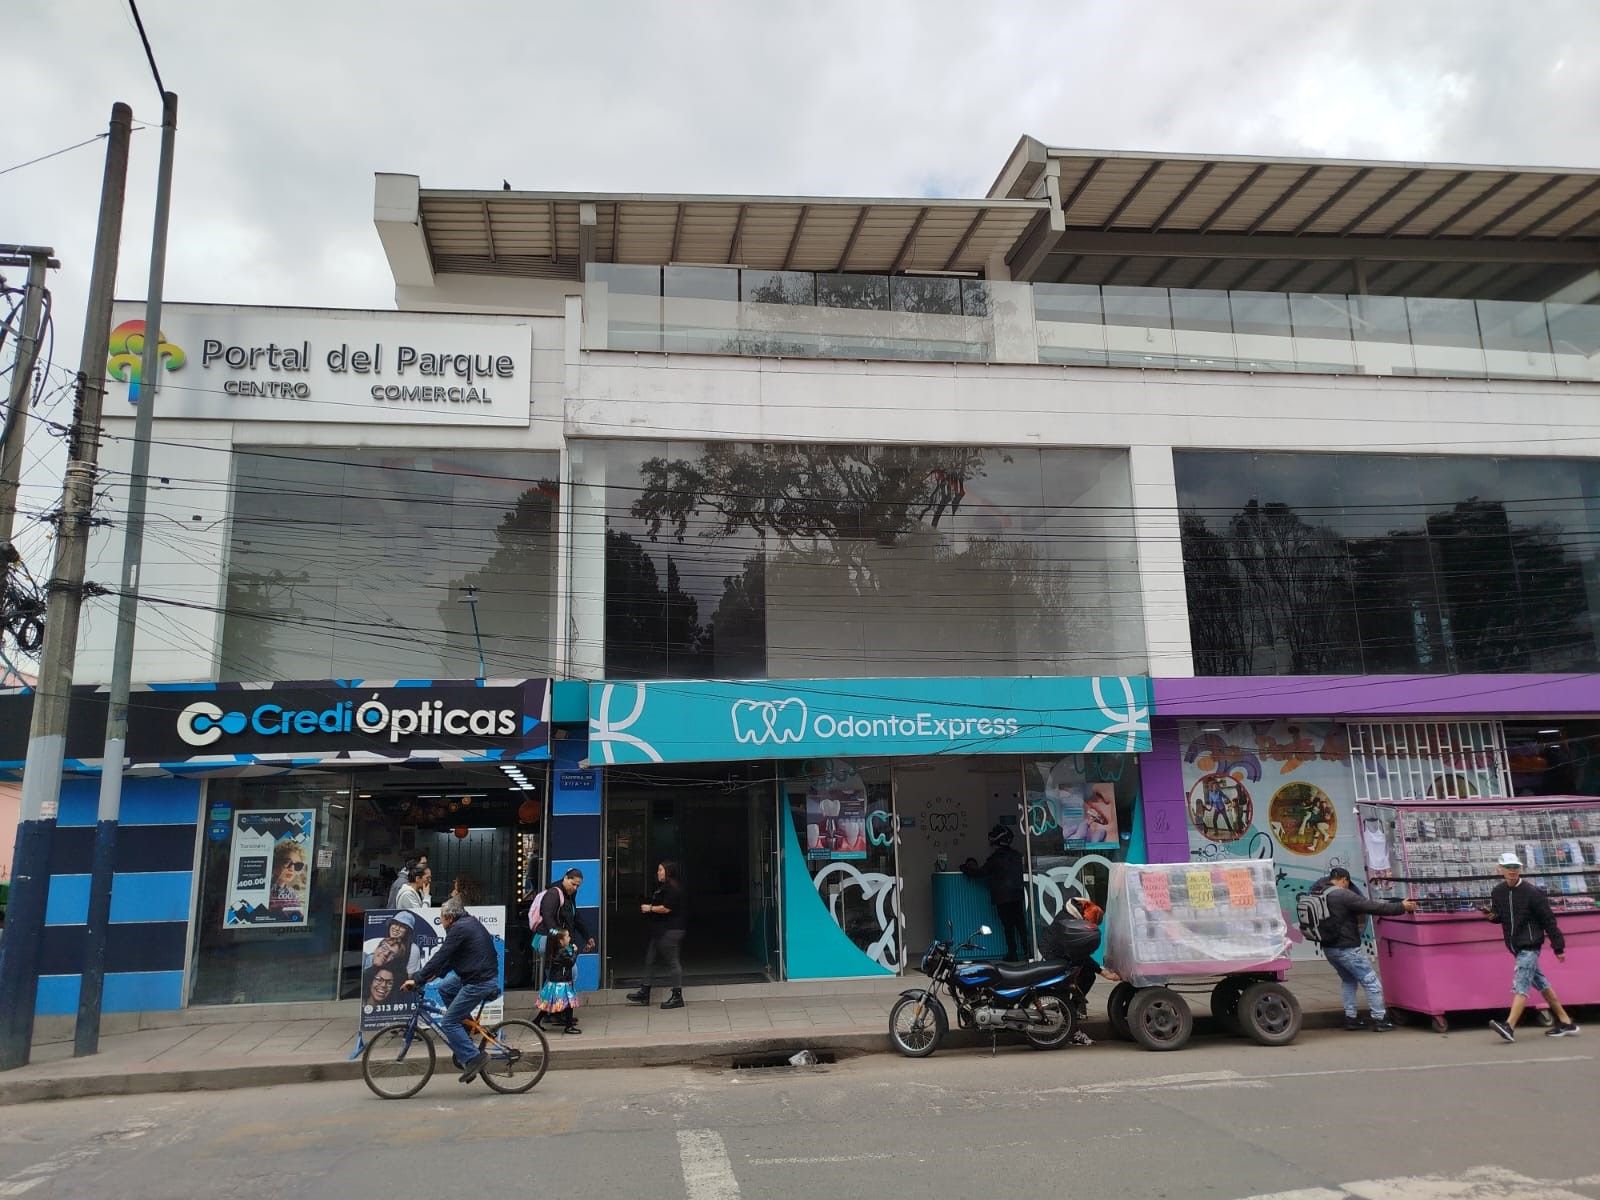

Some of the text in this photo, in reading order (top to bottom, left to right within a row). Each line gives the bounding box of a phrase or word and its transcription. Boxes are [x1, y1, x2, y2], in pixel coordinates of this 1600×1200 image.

[202, 338, 515, 384] Portal del Parque
[223, 379, 493, 403] CENTRO COMERCIAL
[813, 712, 1019, 740] OdontoExpress
[375, 1004, 392, 1012] 313
[393, 1003, 408, 1012] 891
